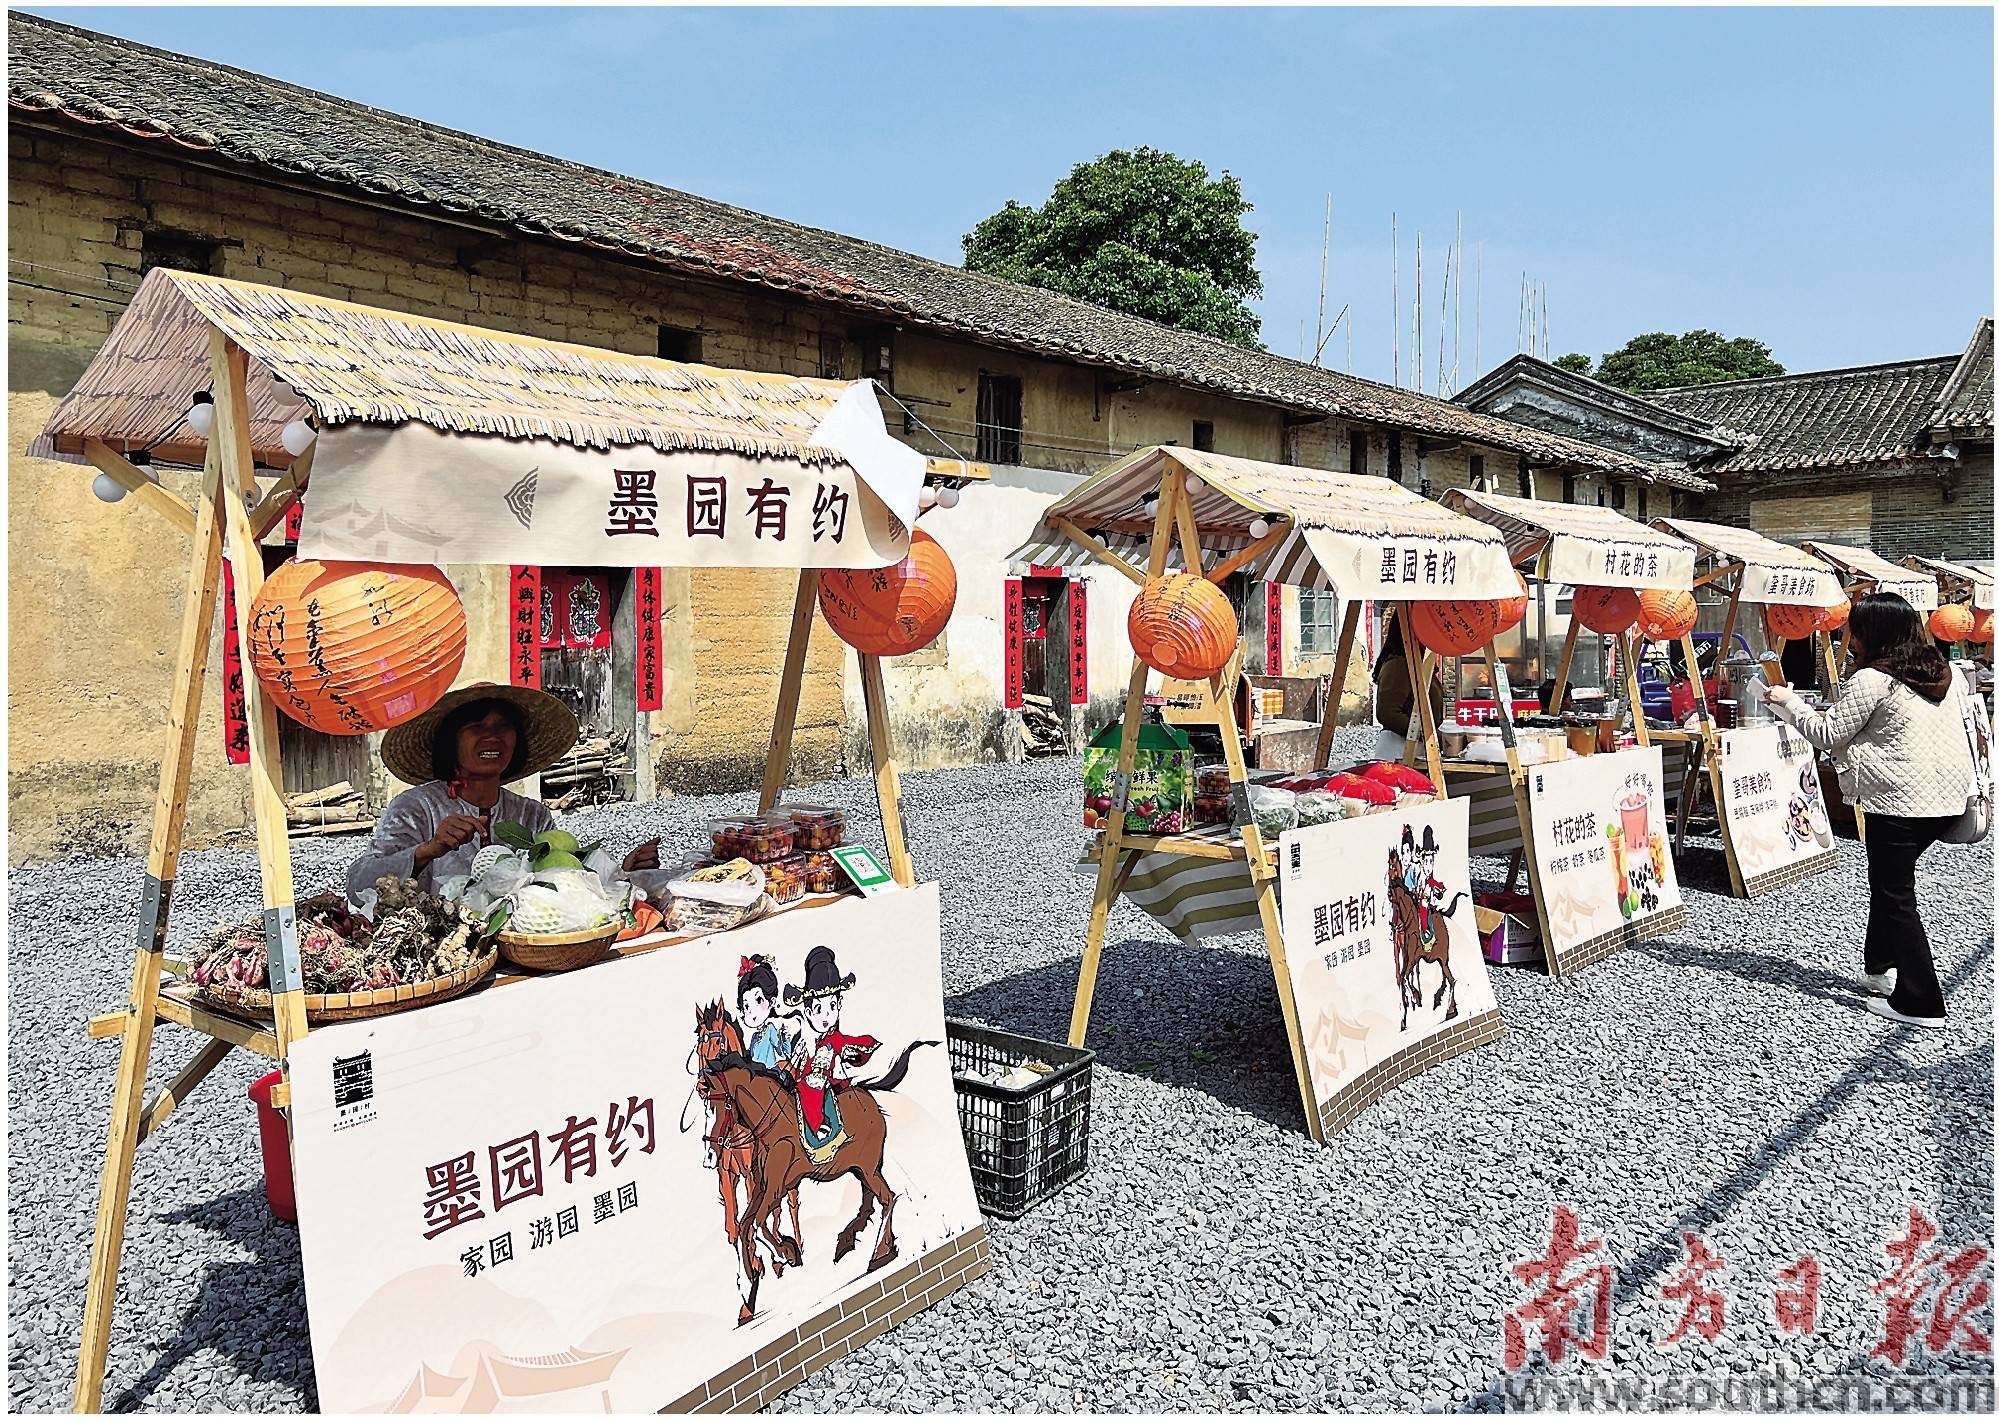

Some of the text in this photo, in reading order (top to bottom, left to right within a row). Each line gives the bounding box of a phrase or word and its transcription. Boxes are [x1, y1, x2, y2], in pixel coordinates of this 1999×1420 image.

[604, 468, 849, 545] 墨园有约
[1380, 546, 1456, 585] 墨园有约
[1605, 549, 1658, 578] 村花的茶
[1552, 812, 1597, 848] 村花的茶
[1313, 891, 1376, 946] 墨园有约
[1357, 938, 1371, 958] 墨园
[422, 1095, 656, 1241] 墨园有约
[460, 1180, 639, 1278] 家园 游园 墨园
